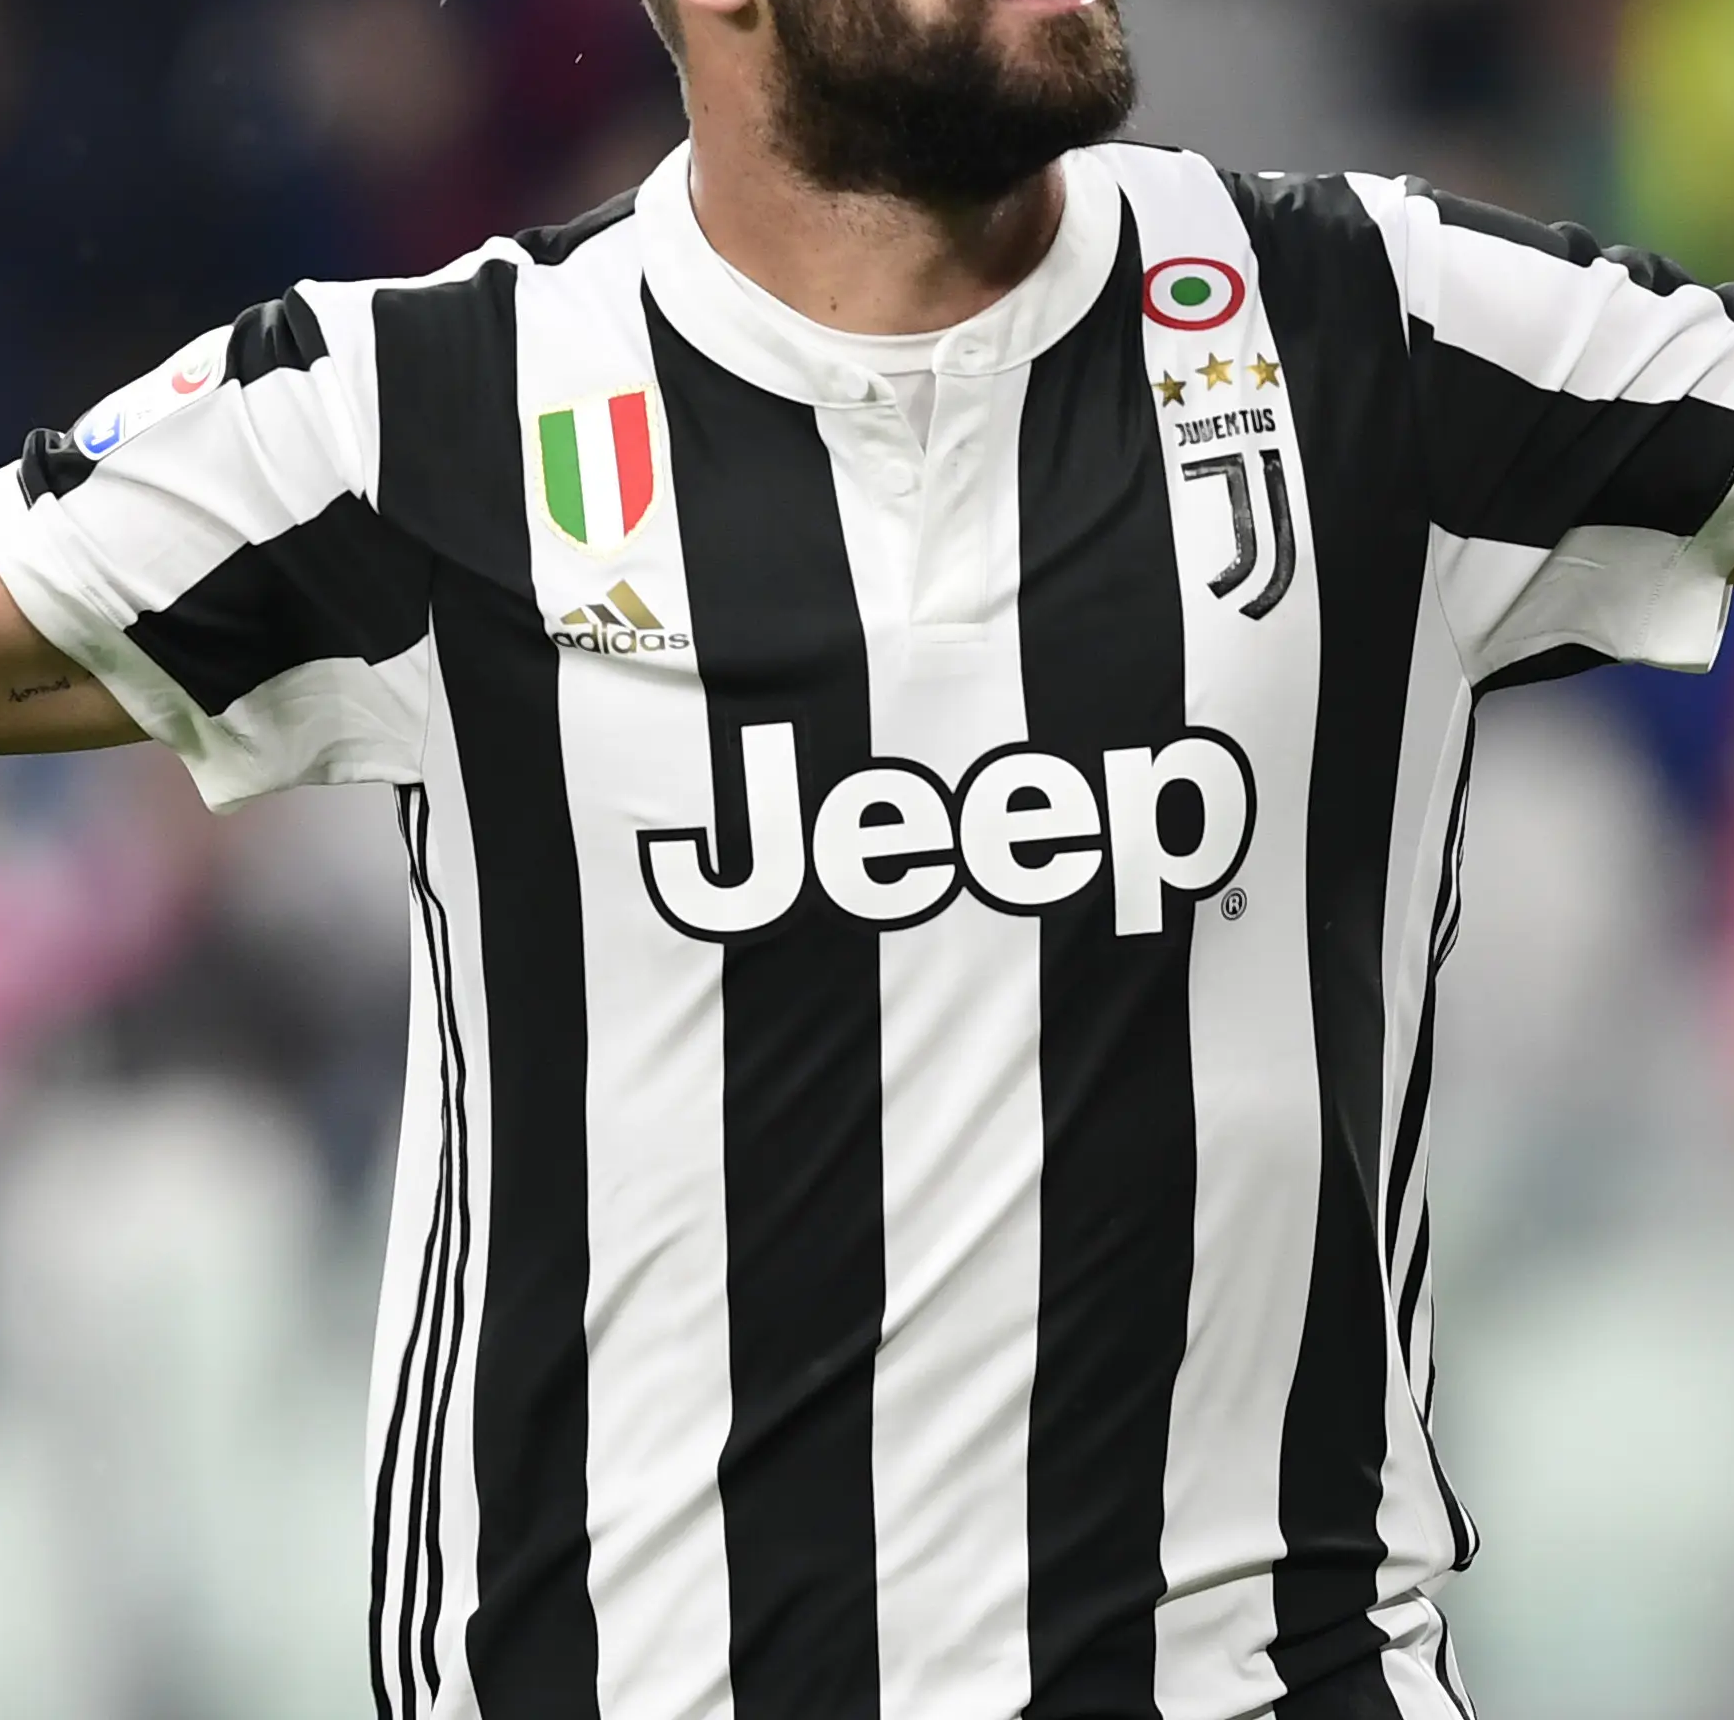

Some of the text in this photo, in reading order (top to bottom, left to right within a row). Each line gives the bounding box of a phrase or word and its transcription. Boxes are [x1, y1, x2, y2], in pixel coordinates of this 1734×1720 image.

[1175, 408, 1277, 447] JUVENTUS
[551, 622, 691, 655] adidas
[637, 720, 1257, 941] Jeep
